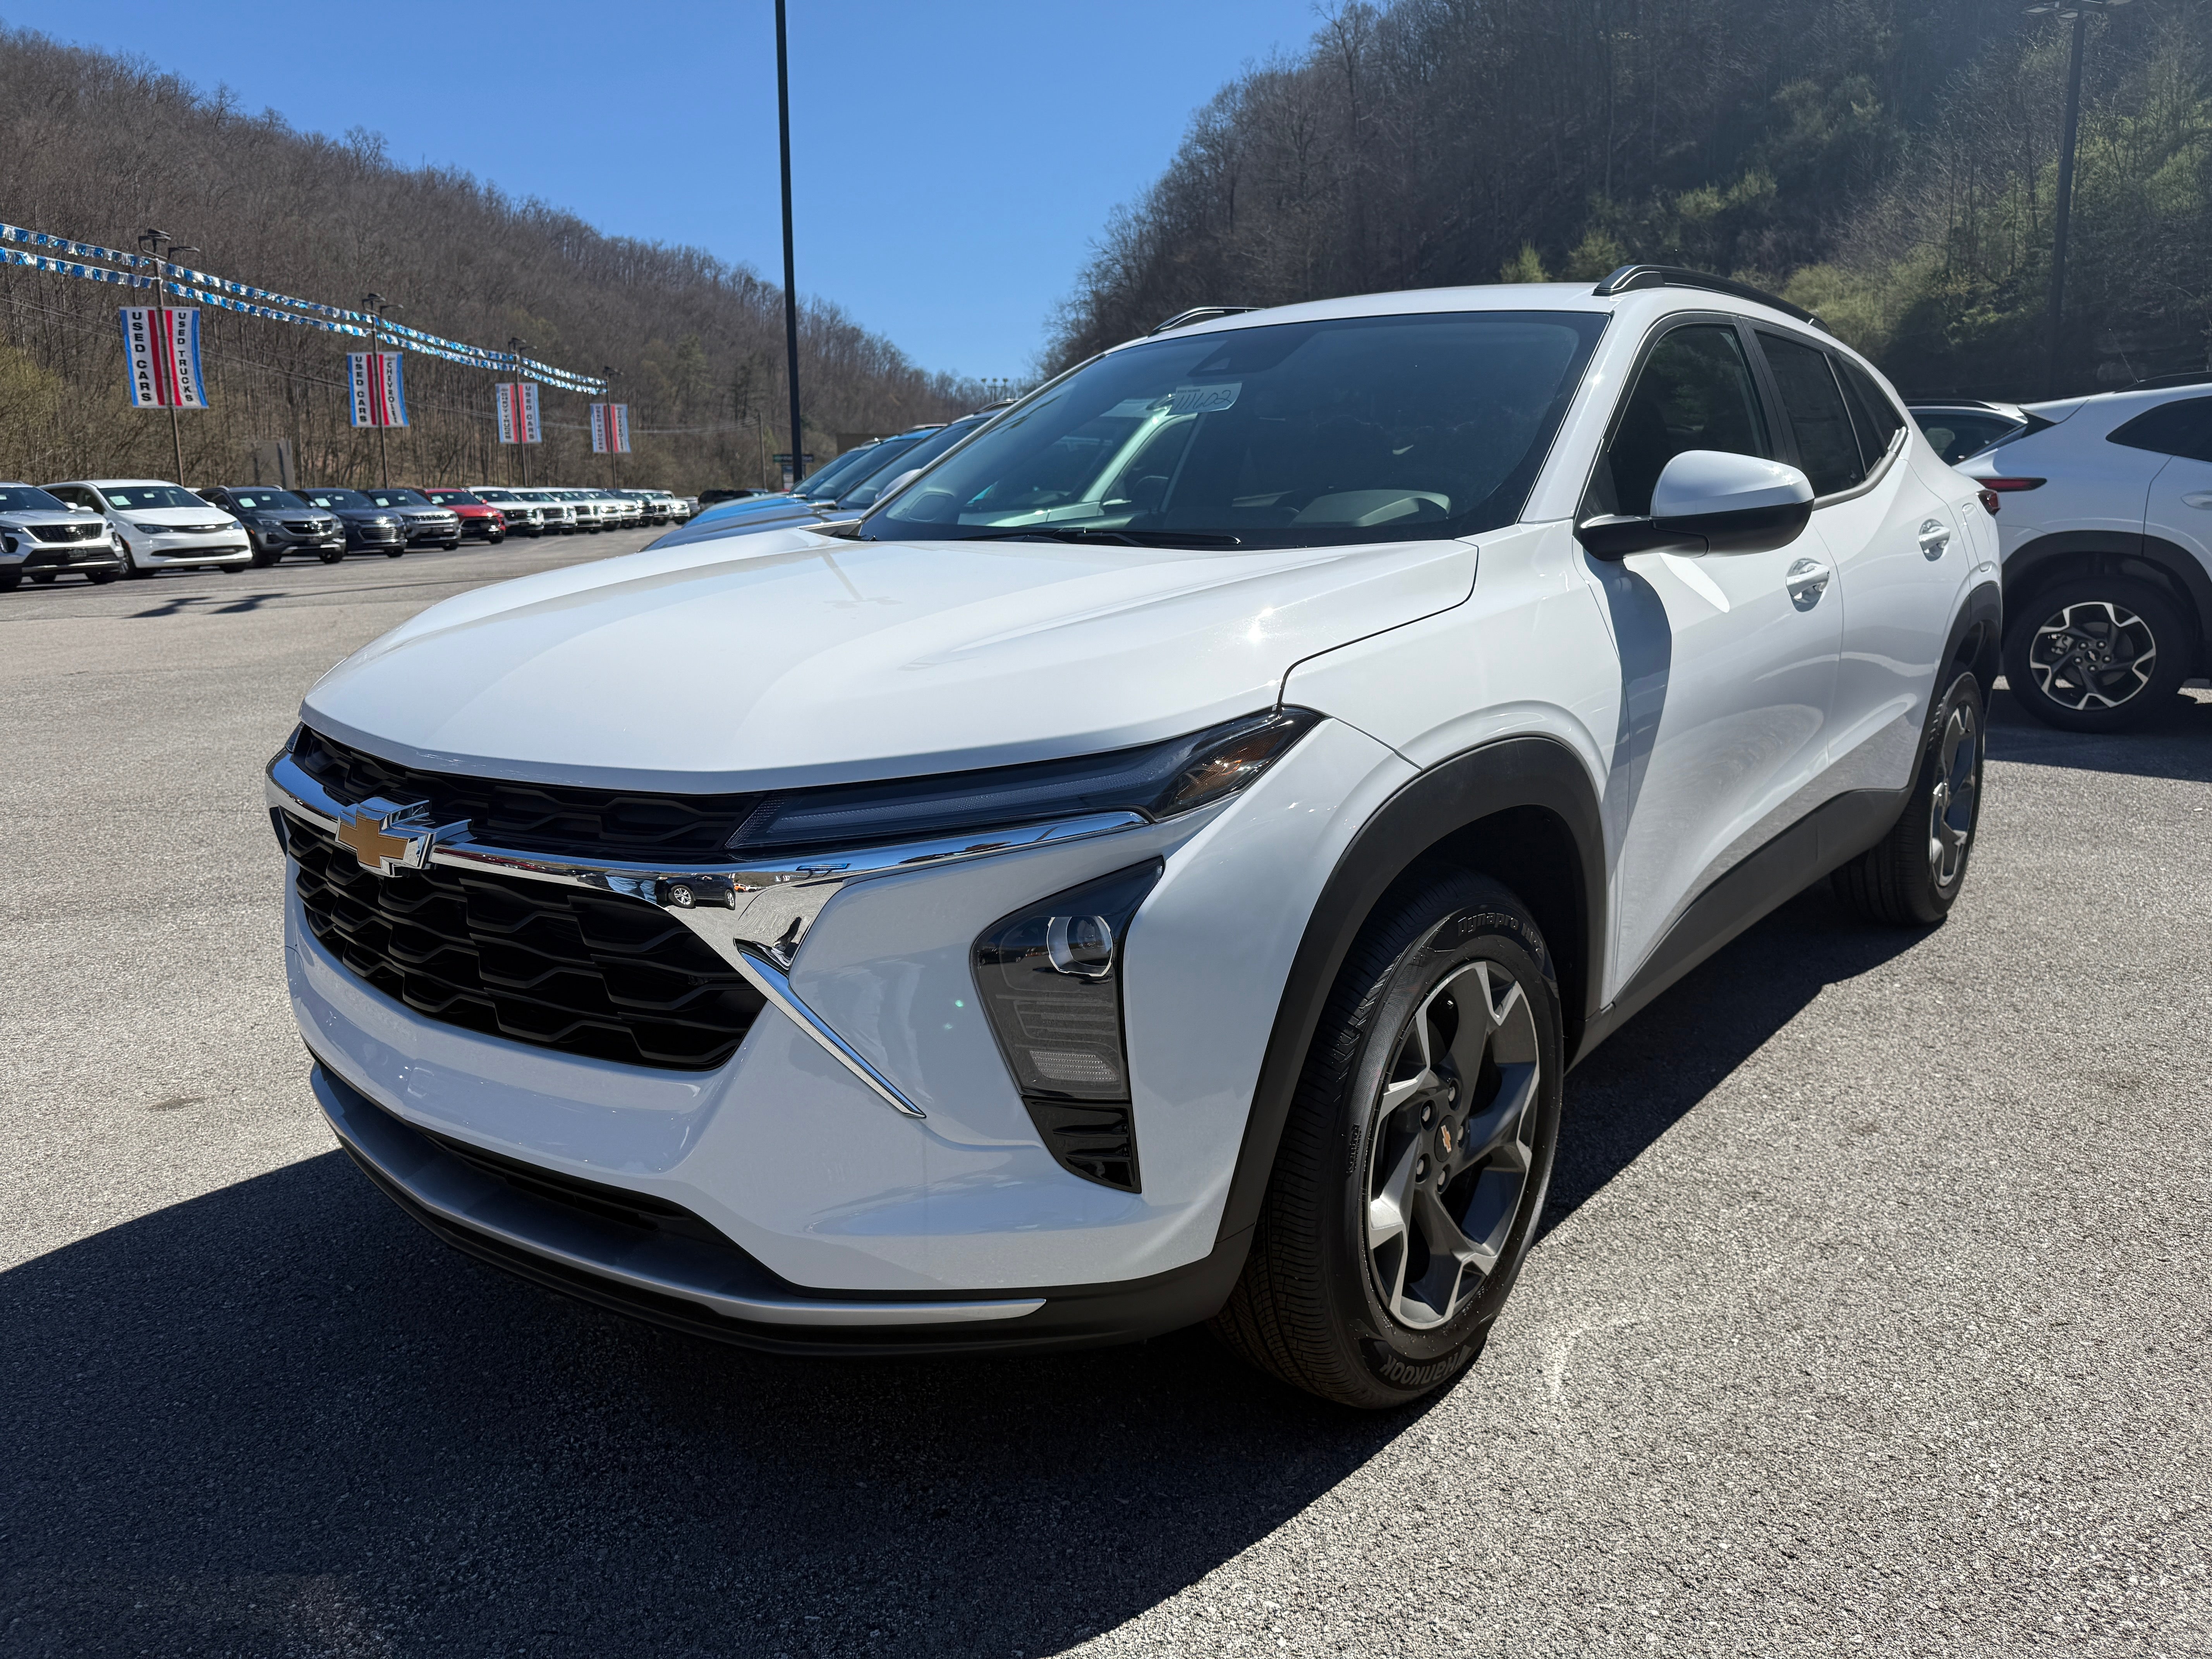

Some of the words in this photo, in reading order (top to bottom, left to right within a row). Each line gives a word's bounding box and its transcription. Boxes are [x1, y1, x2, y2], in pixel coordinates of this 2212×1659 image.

[132, 312, 146, 352] USED
[177, 313, 187, 345] USED
[136, 361, 151, 401] CARS
[178, 350, 193, 401] TRUCKS
[355, 356, 364, 386] USED
[357, 391, 367, 422] CARS
[526, 414, 534, 440] CARS
[1458, 912, 1519, 936] Dynapro
